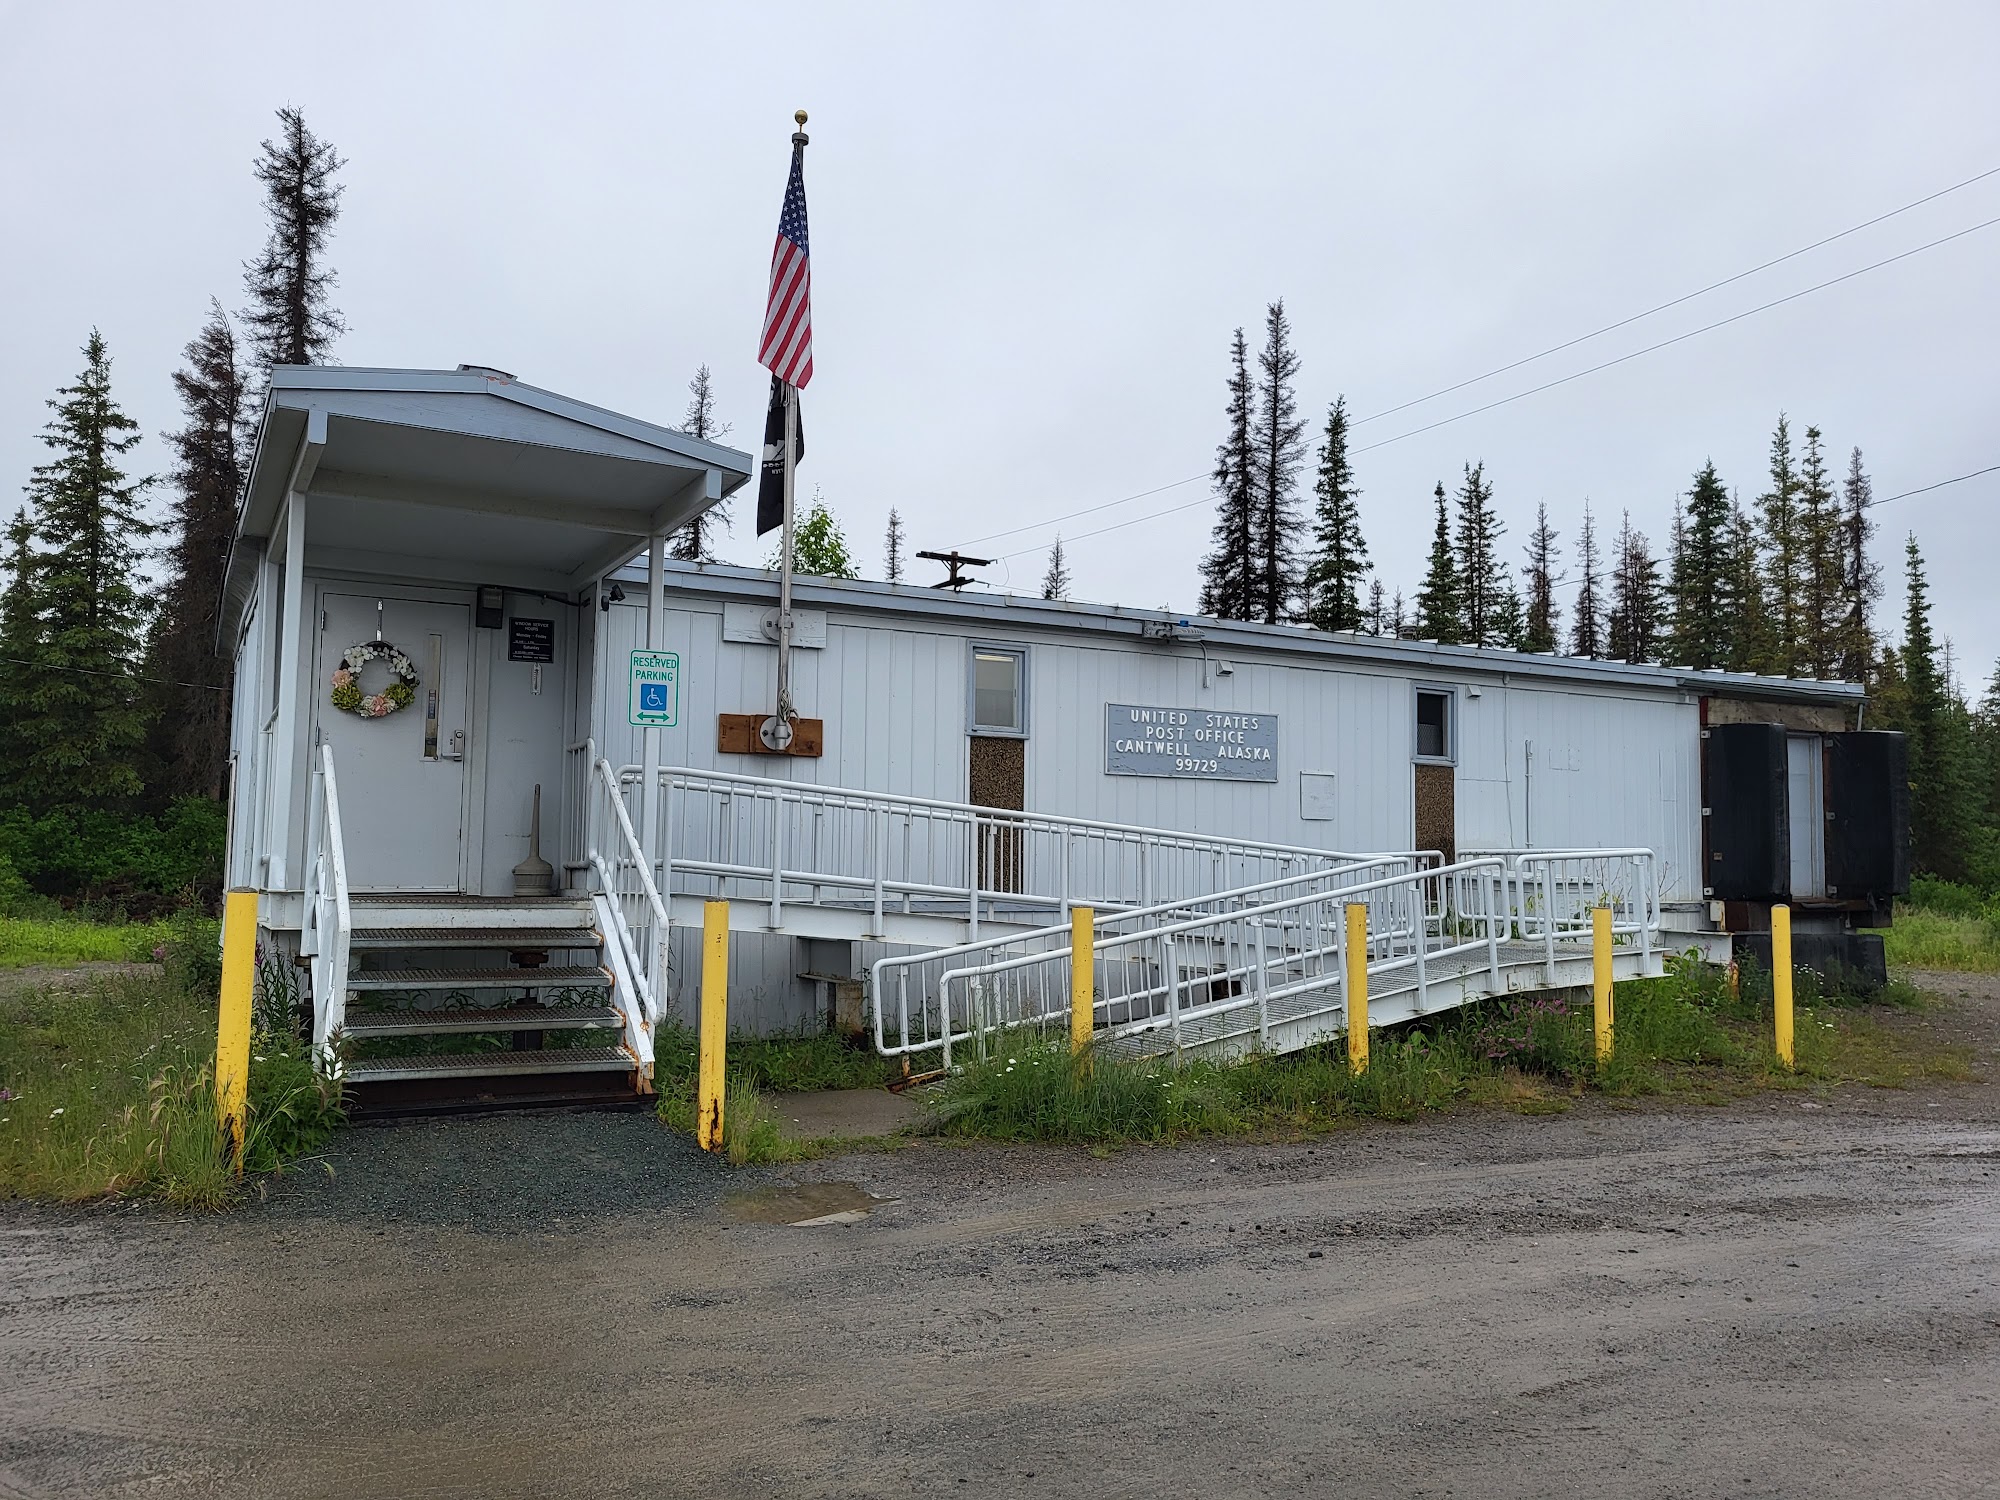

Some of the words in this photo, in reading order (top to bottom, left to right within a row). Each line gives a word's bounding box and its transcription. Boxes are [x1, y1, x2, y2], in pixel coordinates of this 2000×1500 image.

[633, 656, 676, 668] RESERVED
[635, 669, 673, 681] PARKING
[1130, 709, 1188, 725] UNITED
[1206, 714, 1259, 730] STATES
[1145, 726, 1185, 741] POST
[1194, 728, 1245, 744] OFFICE
[1115, 739, 1191, 756] CANTWELL
[1218, 745, 1271, 761] ALASKA
[1175, 758, 1218, 773] 99729
